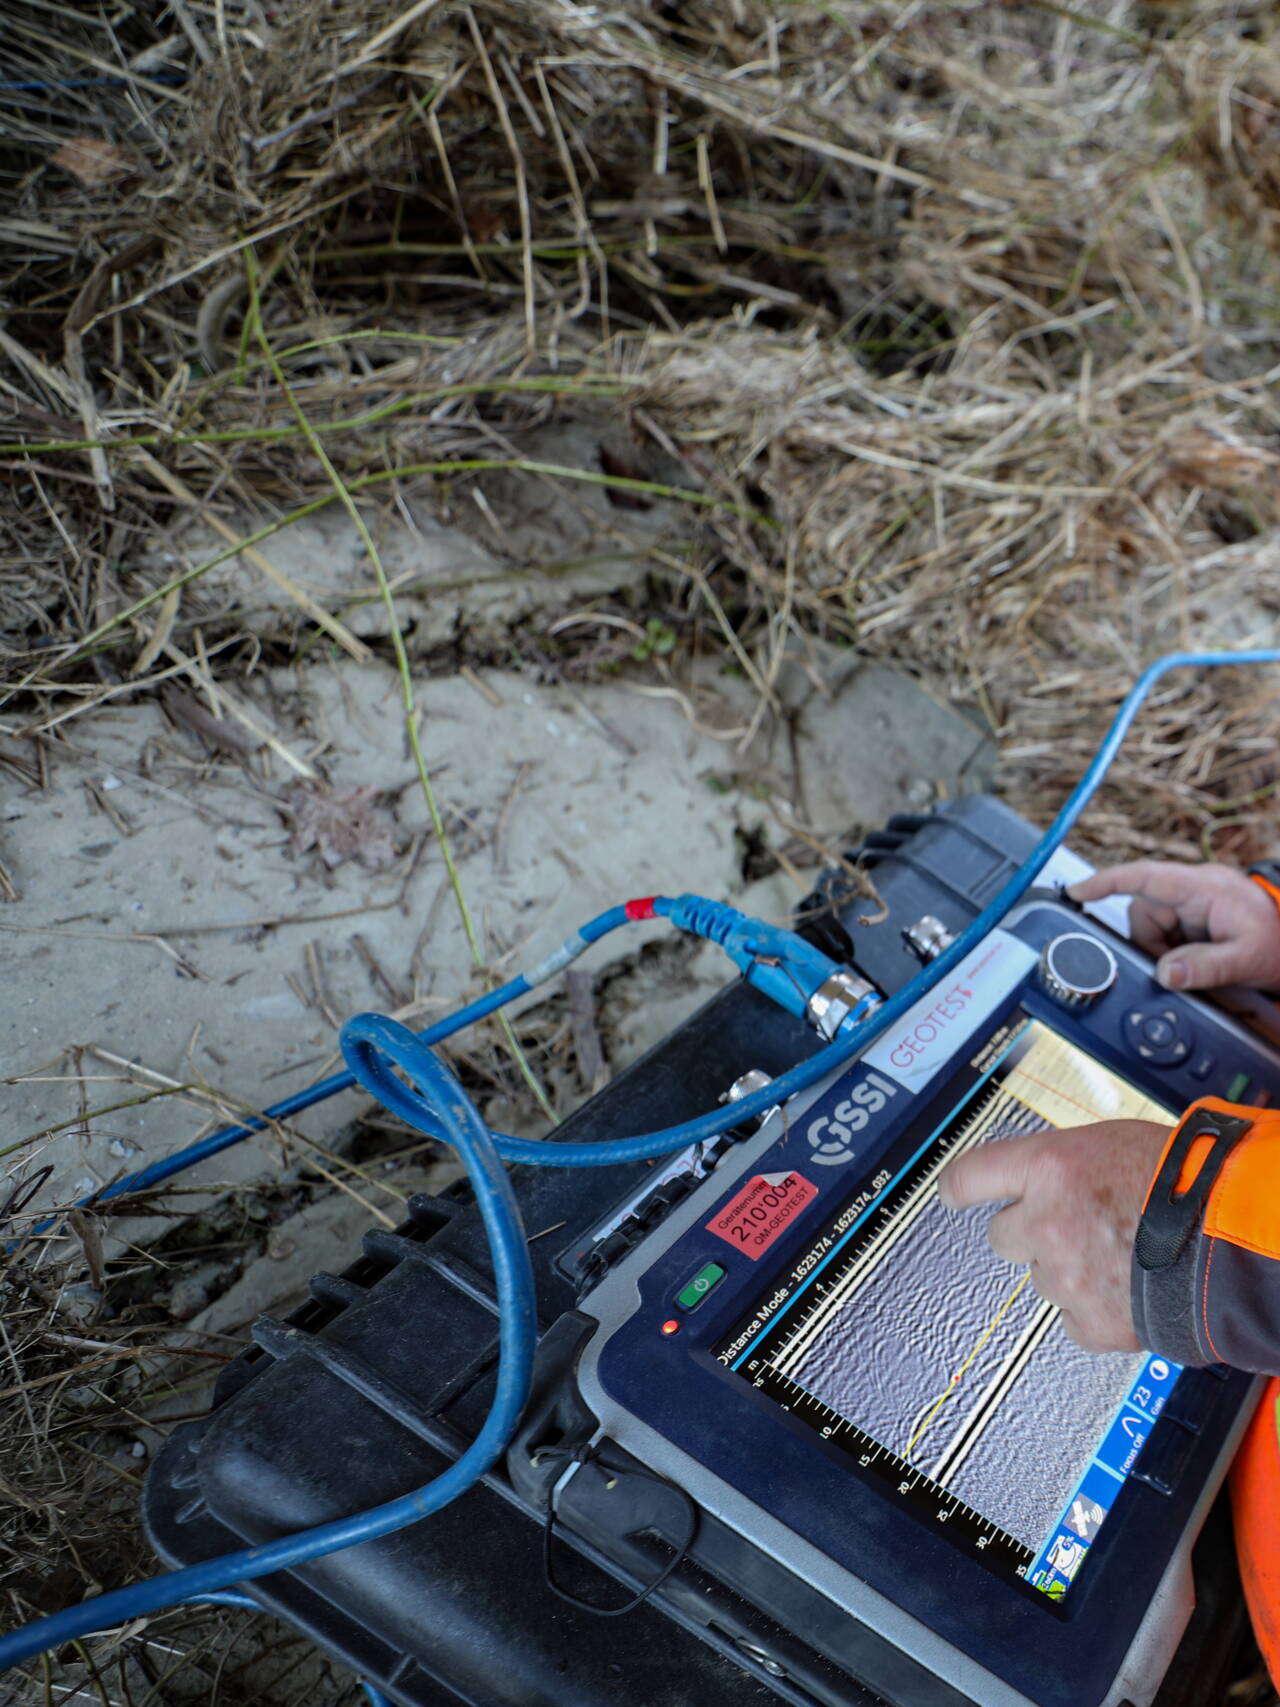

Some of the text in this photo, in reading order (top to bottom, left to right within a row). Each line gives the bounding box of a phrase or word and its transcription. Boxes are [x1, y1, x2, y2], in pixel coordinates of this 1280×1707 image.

[890, 984, 974, 1068] GEOTEST
[807, 1073, 897, 1165] GSSI
[754, 1187, 809, 1245] QM-GEOTEST
[717, 1319, 762, 1366] Distance
[757, 1286, 790, 1322] Mode
[791, 1237, 833, 1282] 1623174
[834, 1169, 892, 1235] 1623174_032
[1133, 1386, 1152, 1408] 23
[1150, 1397, 1165, 1416] Gain
[819, 1426, 832, 1439] 10
[858, 1455, 871, 1468] 15
[1120, 1433, 1146, 1474] Focus Off
[898, 1481, 911, 1495] 20
[937, 1509, 949, 1522] 25
[976, 1536, 988, 1550] 30
[1015, 1565, 1027, 1579] 35
